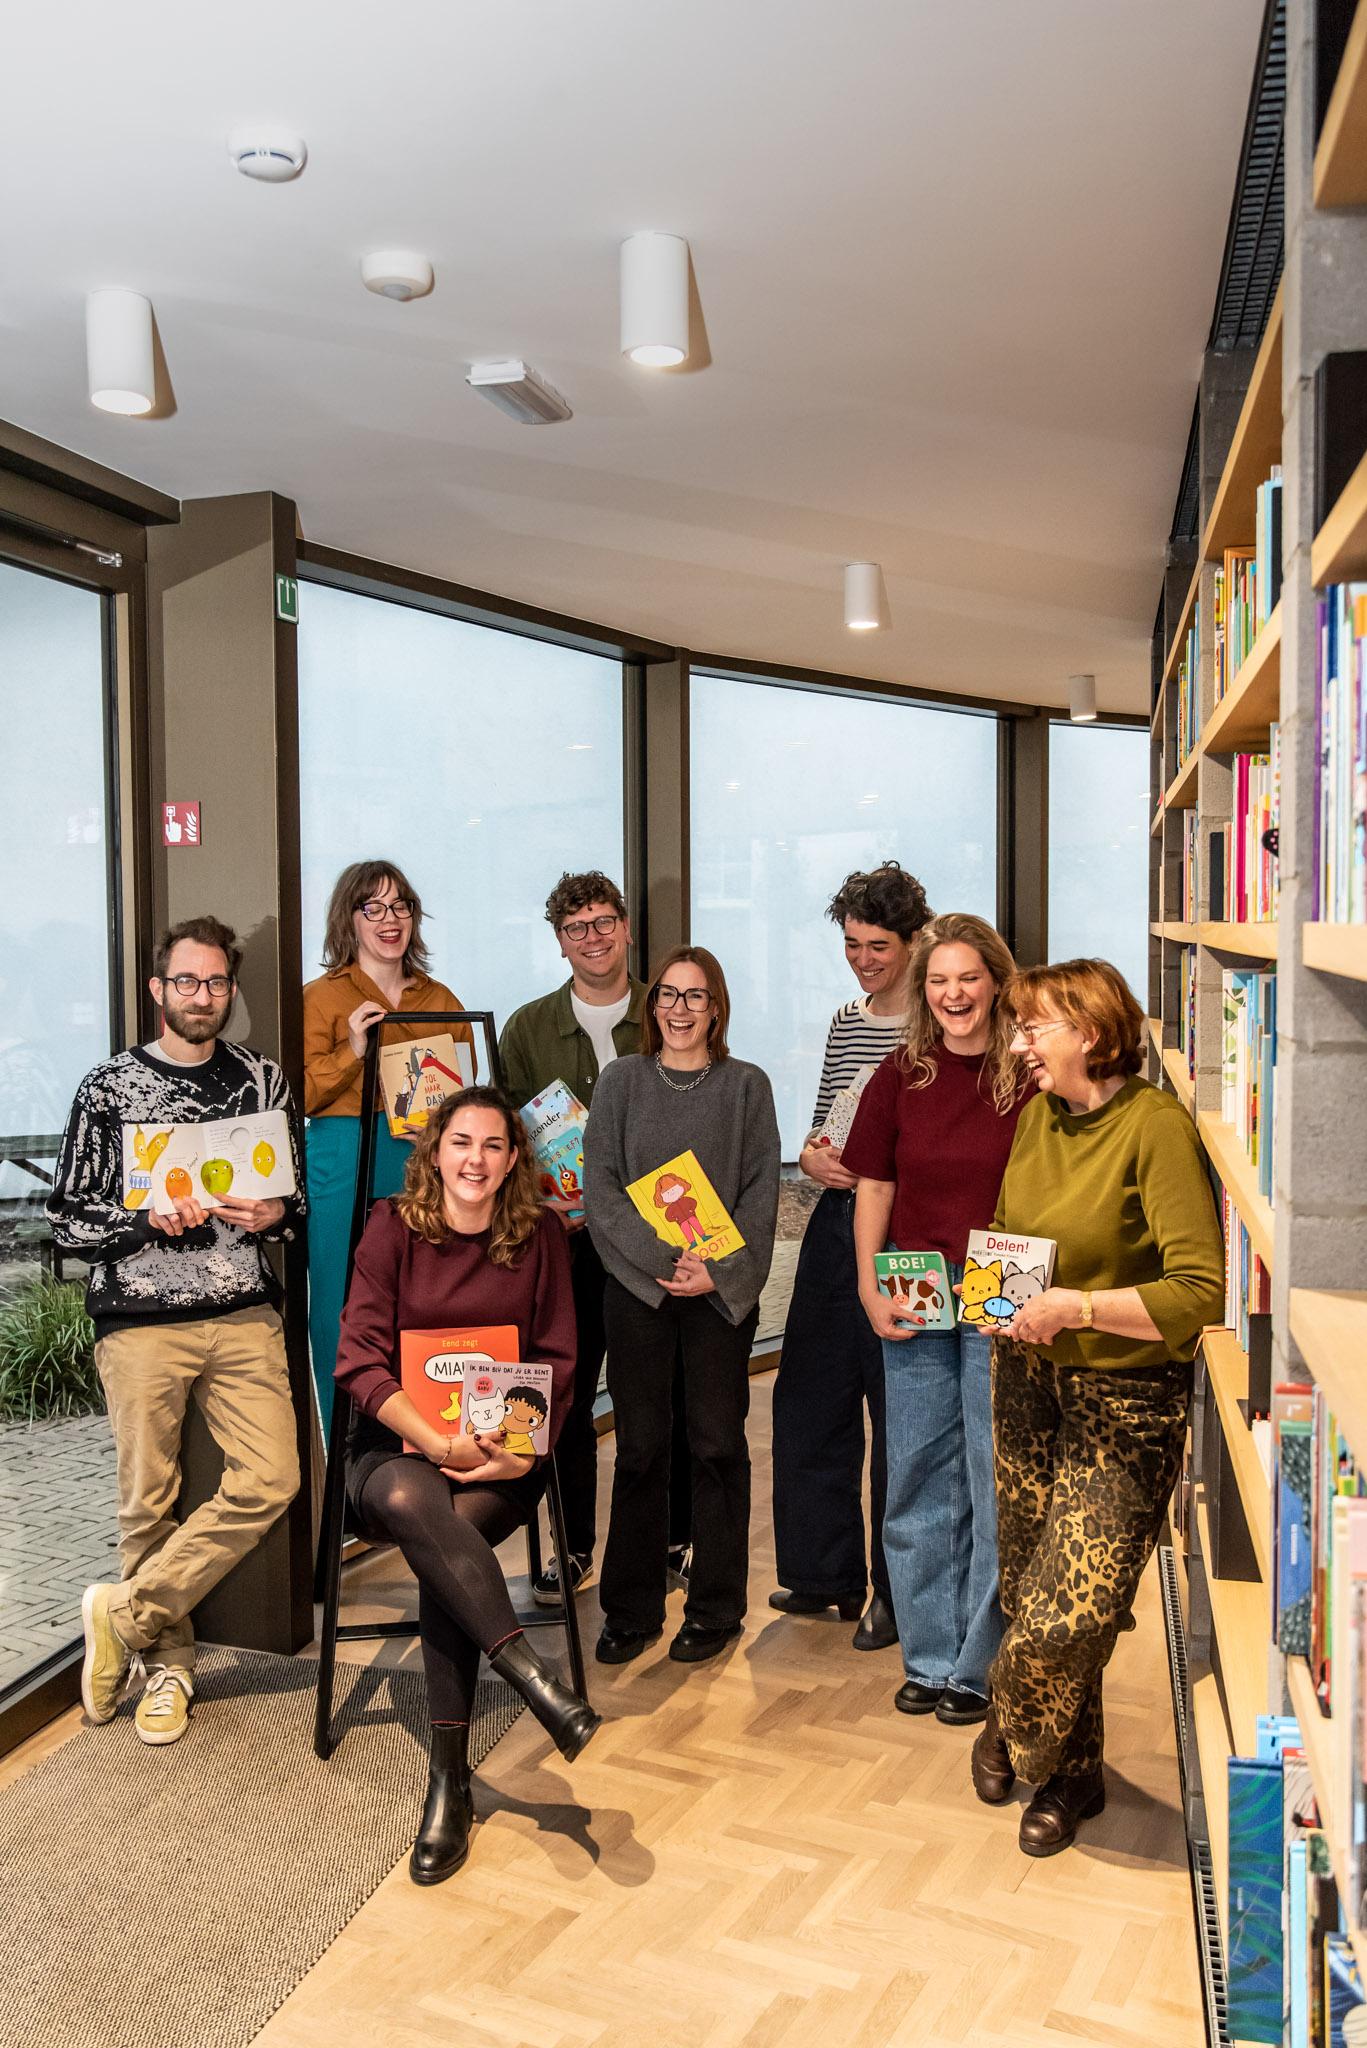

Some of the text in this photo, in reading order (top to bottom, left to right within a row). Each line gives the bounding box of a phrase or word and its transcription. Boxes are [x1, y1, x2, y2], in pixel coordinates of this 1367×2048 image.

[425, 1074, 437, 1083] TOE
[530, 1112, 561, 1142] ijzonder
[699, 1235, 730, 1257] OOT!
[986, 1237, 1029, 1254] Delen!
[888, 1256, 926, 1270] BOE!
[442, 1340, 460, 1348] Eend
[462, 1339, 479, 1348] zegt
[434, 1361, 465, 1376] MIA
